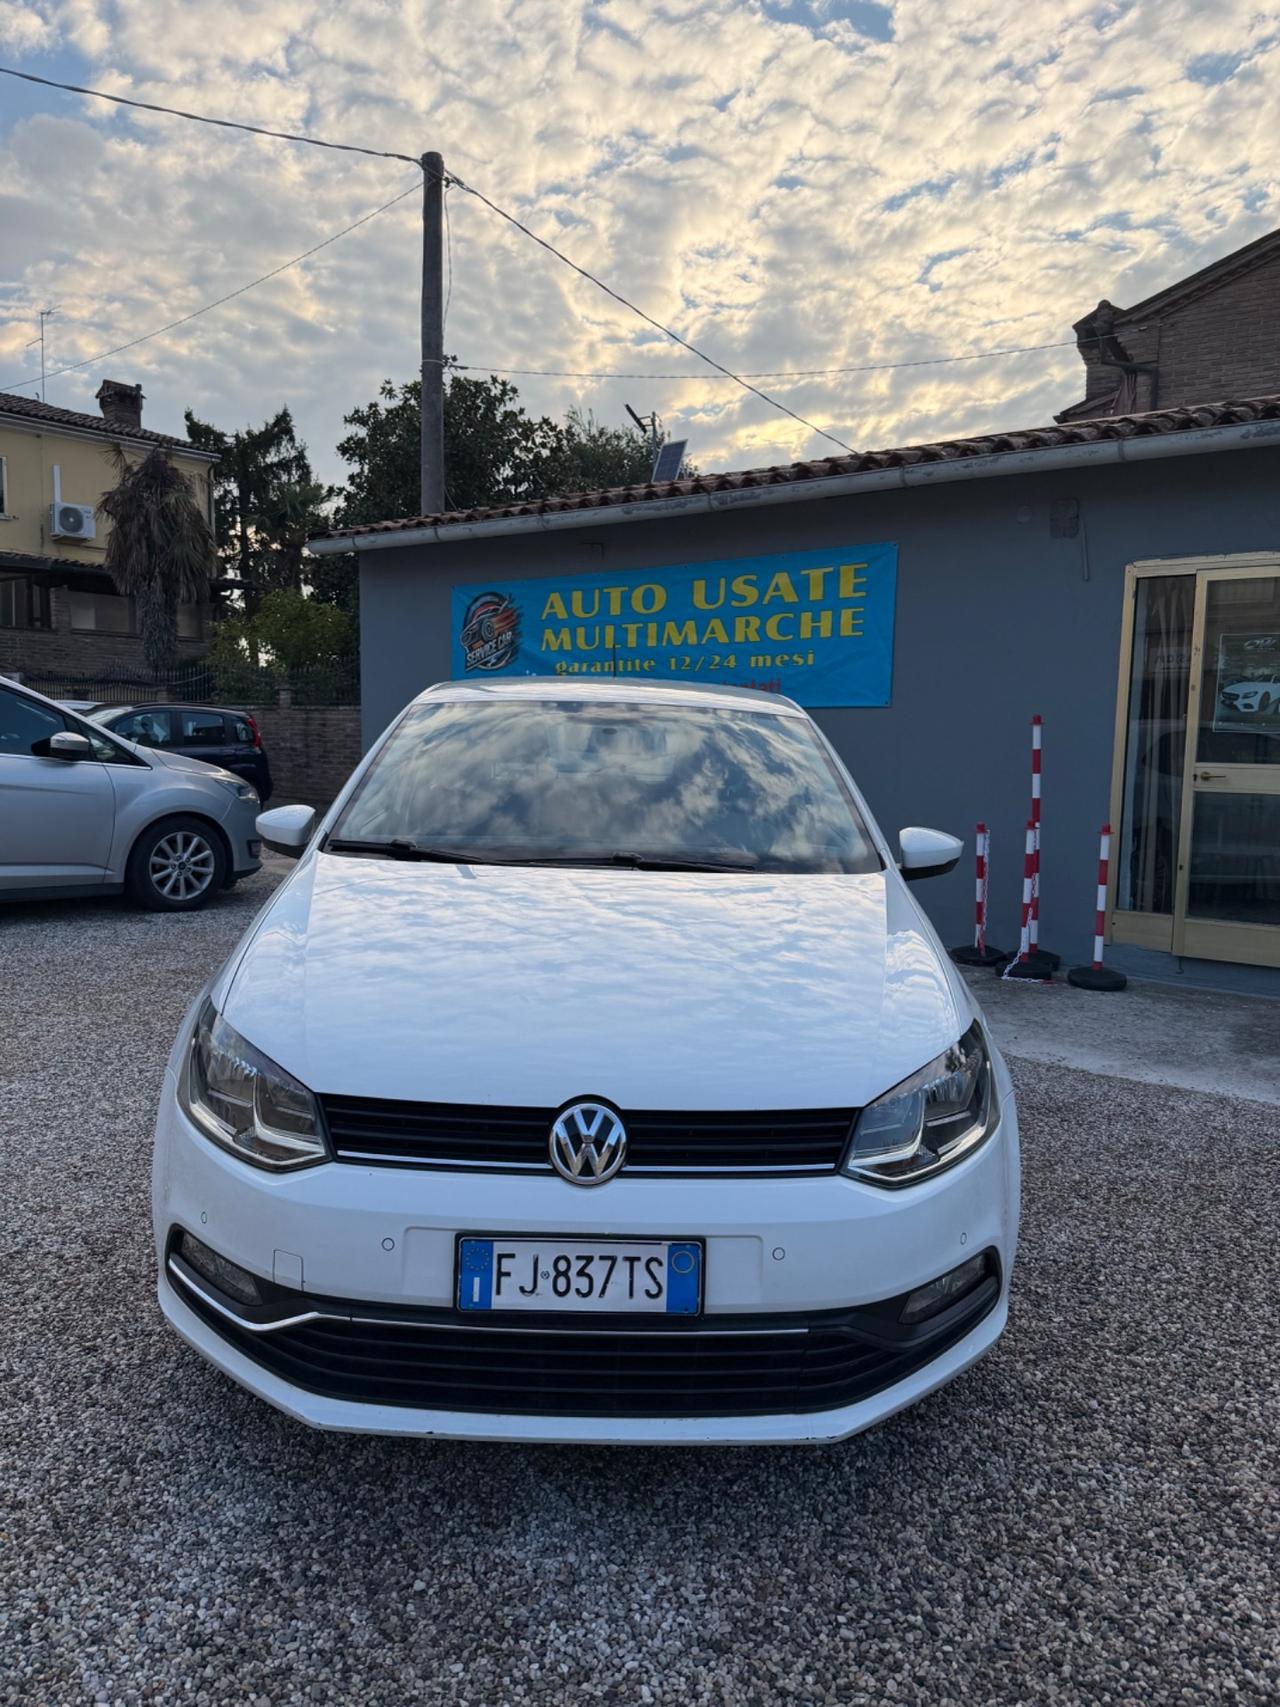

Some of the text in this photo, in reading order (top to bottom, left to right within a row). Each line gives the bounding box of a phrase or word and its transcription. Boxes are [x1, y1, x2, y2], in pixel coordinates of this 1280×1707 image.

[541, 563, 870, 620] AUTO USATE
[540, 608, 866, 652] MULTIMARCHE
[555, 649, 815, 676] garantite 12/24 mesi
